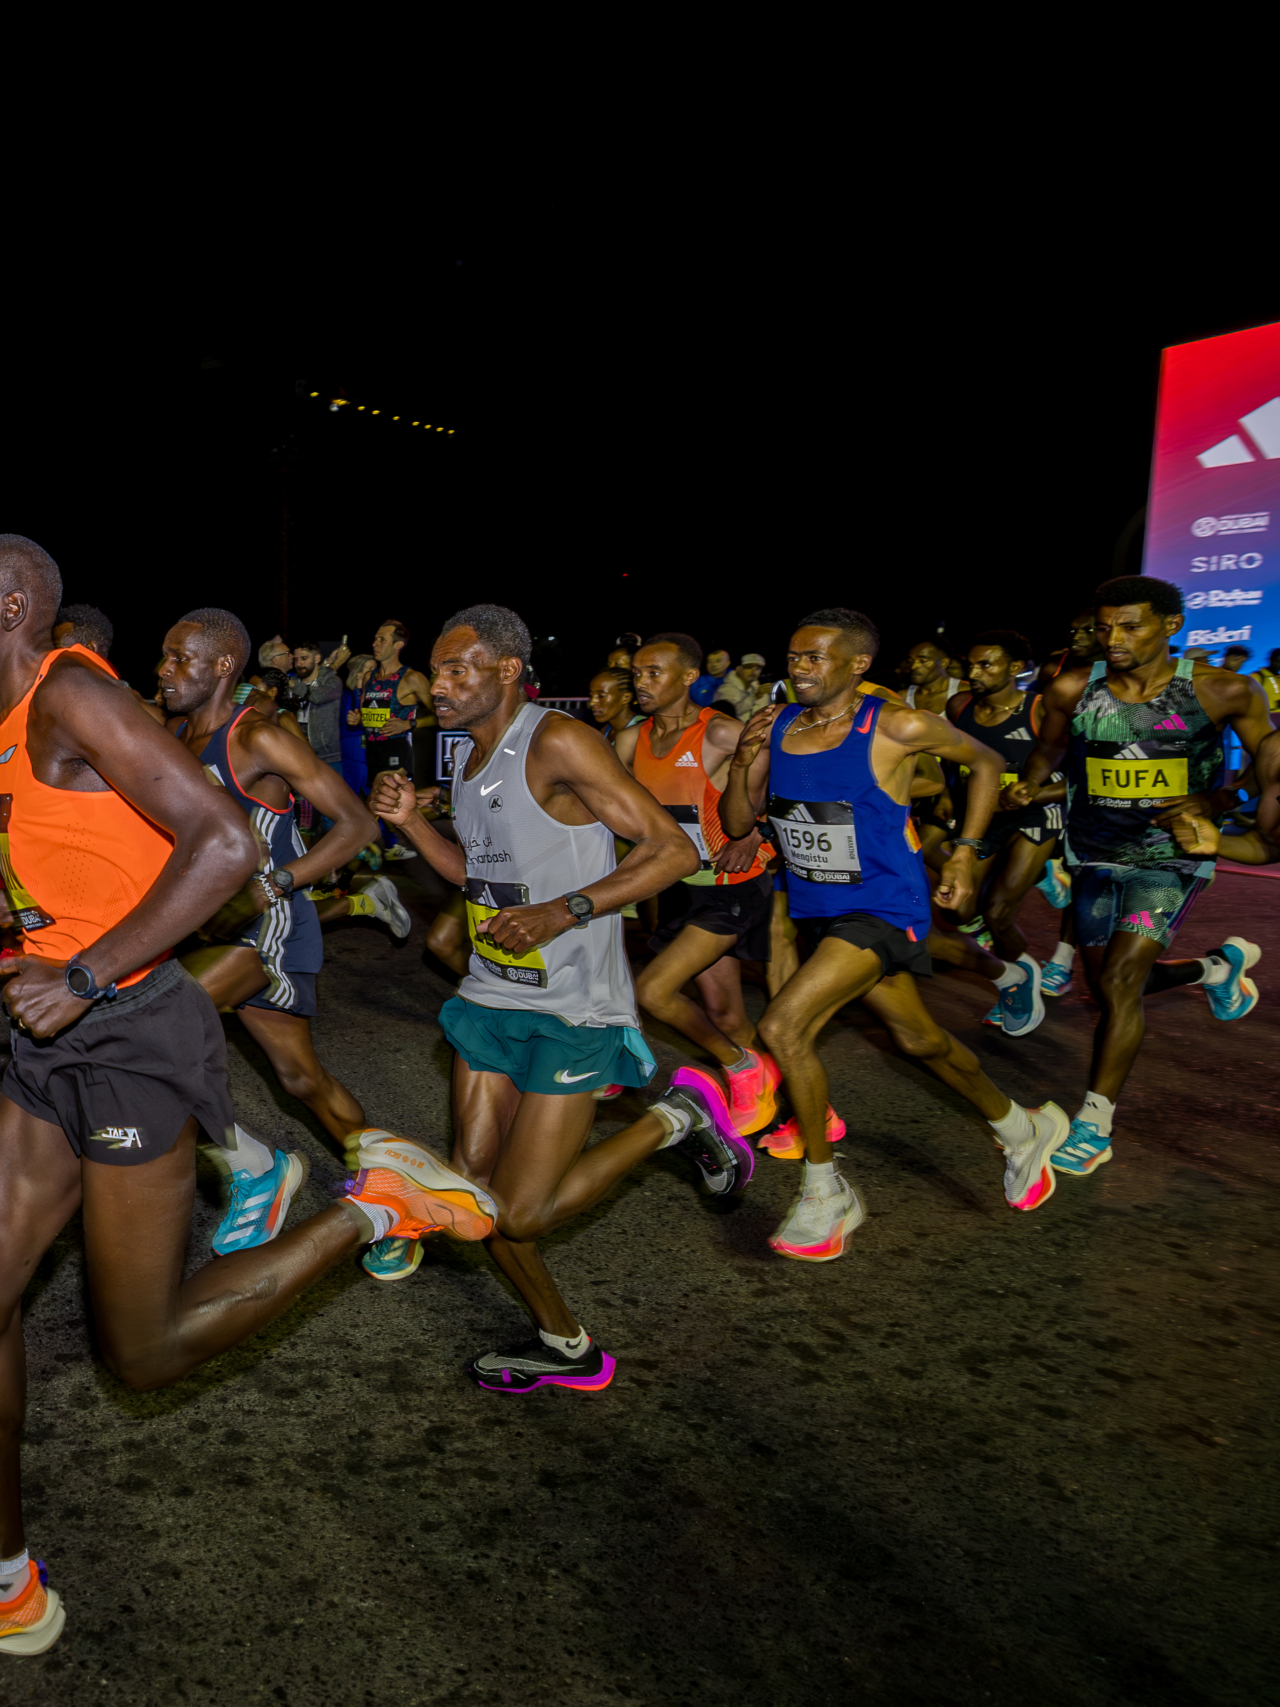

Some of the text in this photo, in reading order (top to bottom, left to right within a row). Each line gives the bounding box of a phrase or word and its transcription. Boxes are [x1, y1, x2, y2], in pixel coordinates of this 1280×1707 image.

[1190, 552, 1263, 573] SIRO
[1101, 769, 1170, 788] FUFA
[783, 827, 832, 852] 1596
[790, 850, 828, 863] Mengistu
